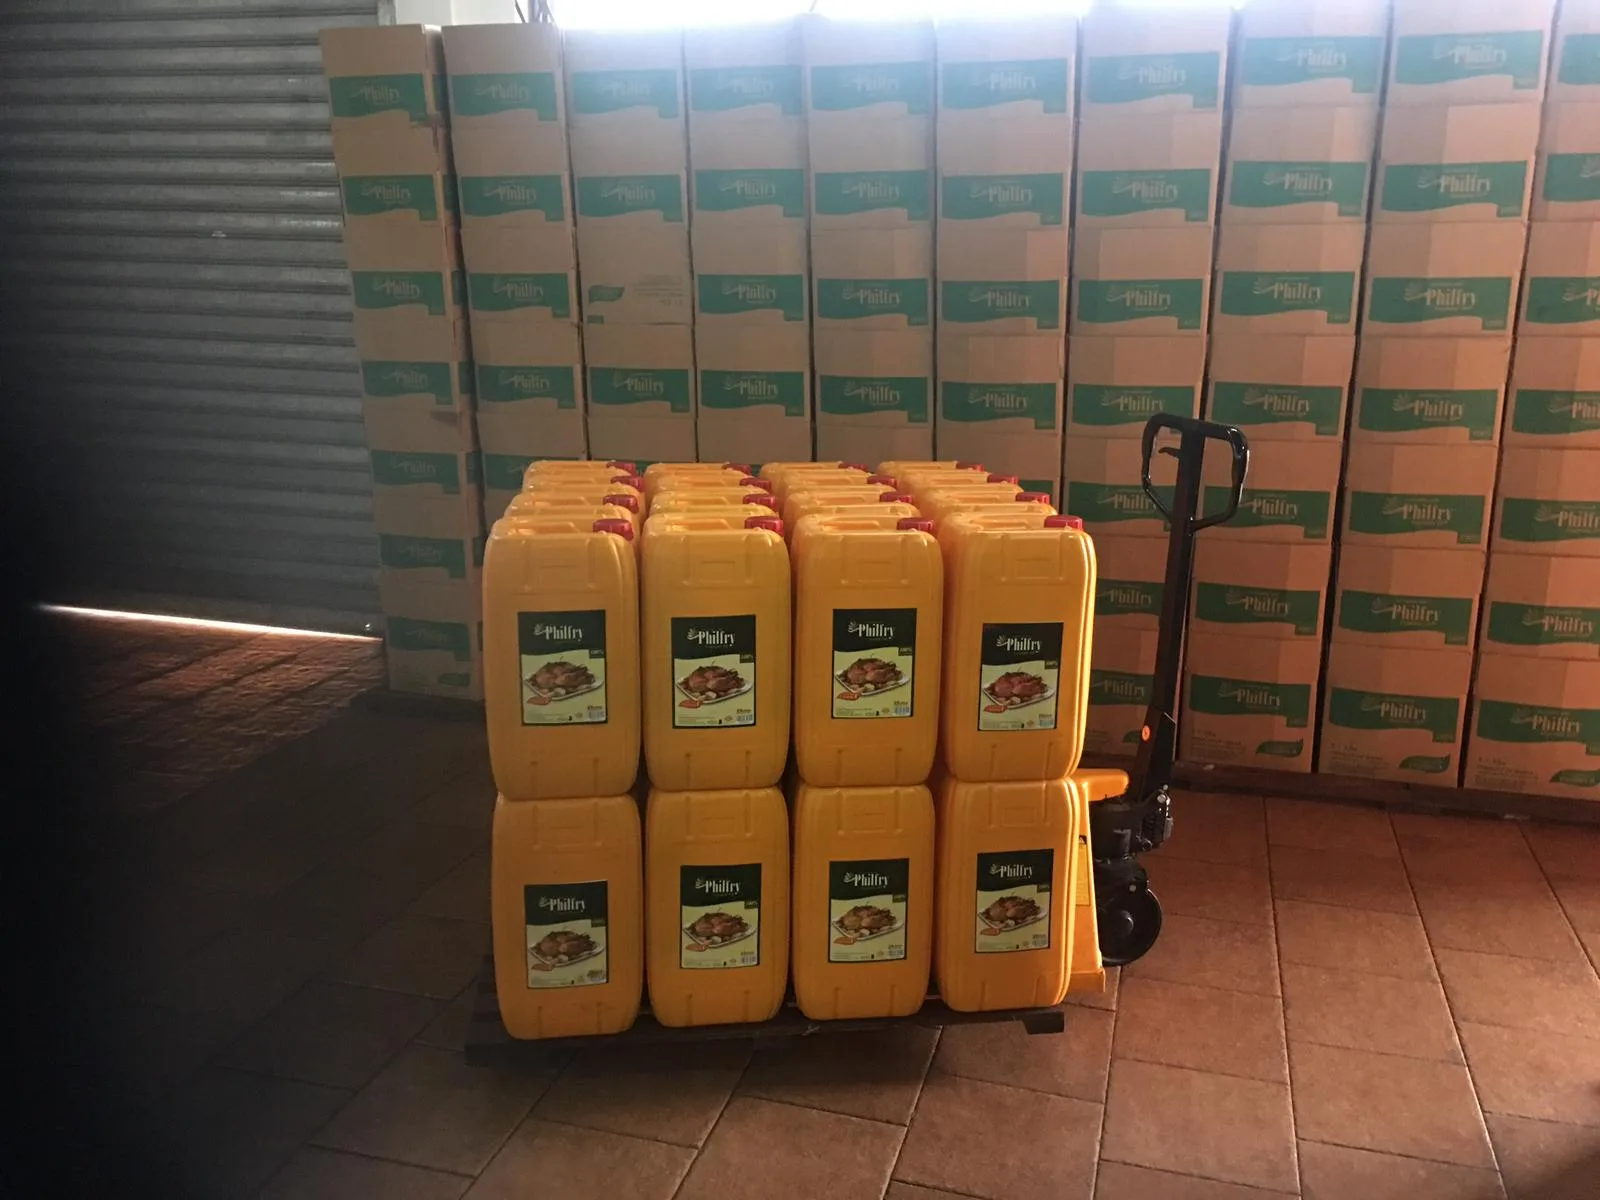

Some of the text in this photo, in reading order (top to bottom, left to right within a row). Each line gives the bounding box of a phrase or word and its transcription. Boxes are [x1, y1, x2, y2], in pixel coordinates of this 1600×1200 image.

[545, 625, 584, 642] Philfry
[698, 630, 735, 647] Philfry
[858, 622, 896, 639] Philfry
[1006, 637, 1042, 653] Philfry
[999, 864, 1033, 878] Philfry
[705, 879, 741, 894] Philfry
[854, 872, 889, 888] Philfry
[550, 897, 585, 912] Philfry
